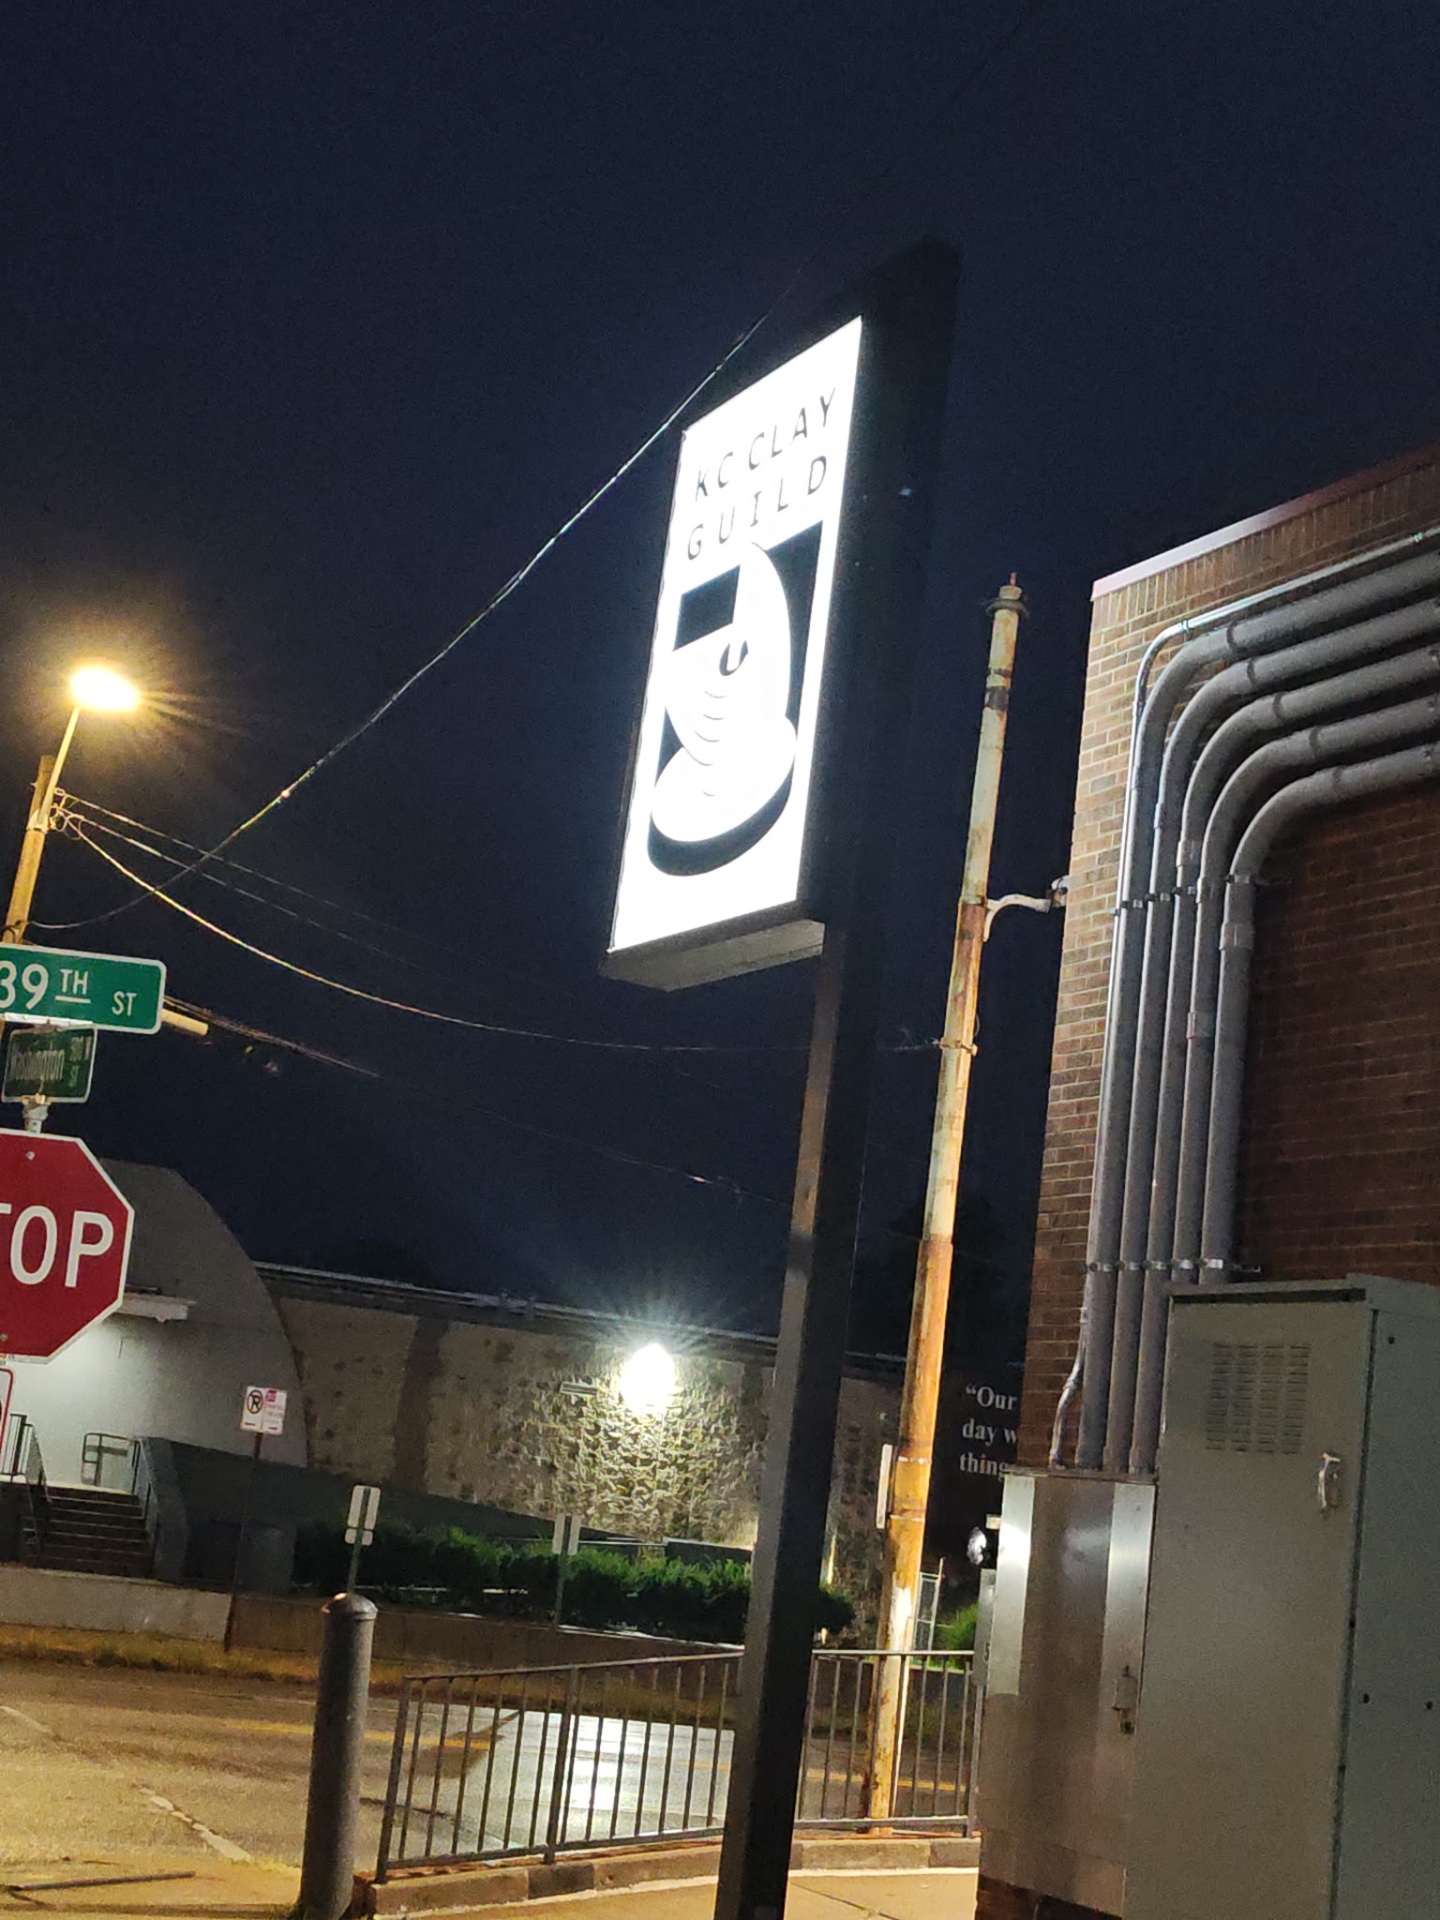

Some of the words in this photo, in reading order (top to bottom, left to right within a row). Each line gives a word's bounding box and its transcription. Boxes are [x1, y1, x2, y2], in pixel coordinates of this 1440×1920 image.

[695, 452, 733, 502] KC
[748, 387, 836, 471] CLAY
[687, 455, 827, 561] GUILD
[112, 991, 137, 1017] ST
[962, 1418, 996, 1447] day
